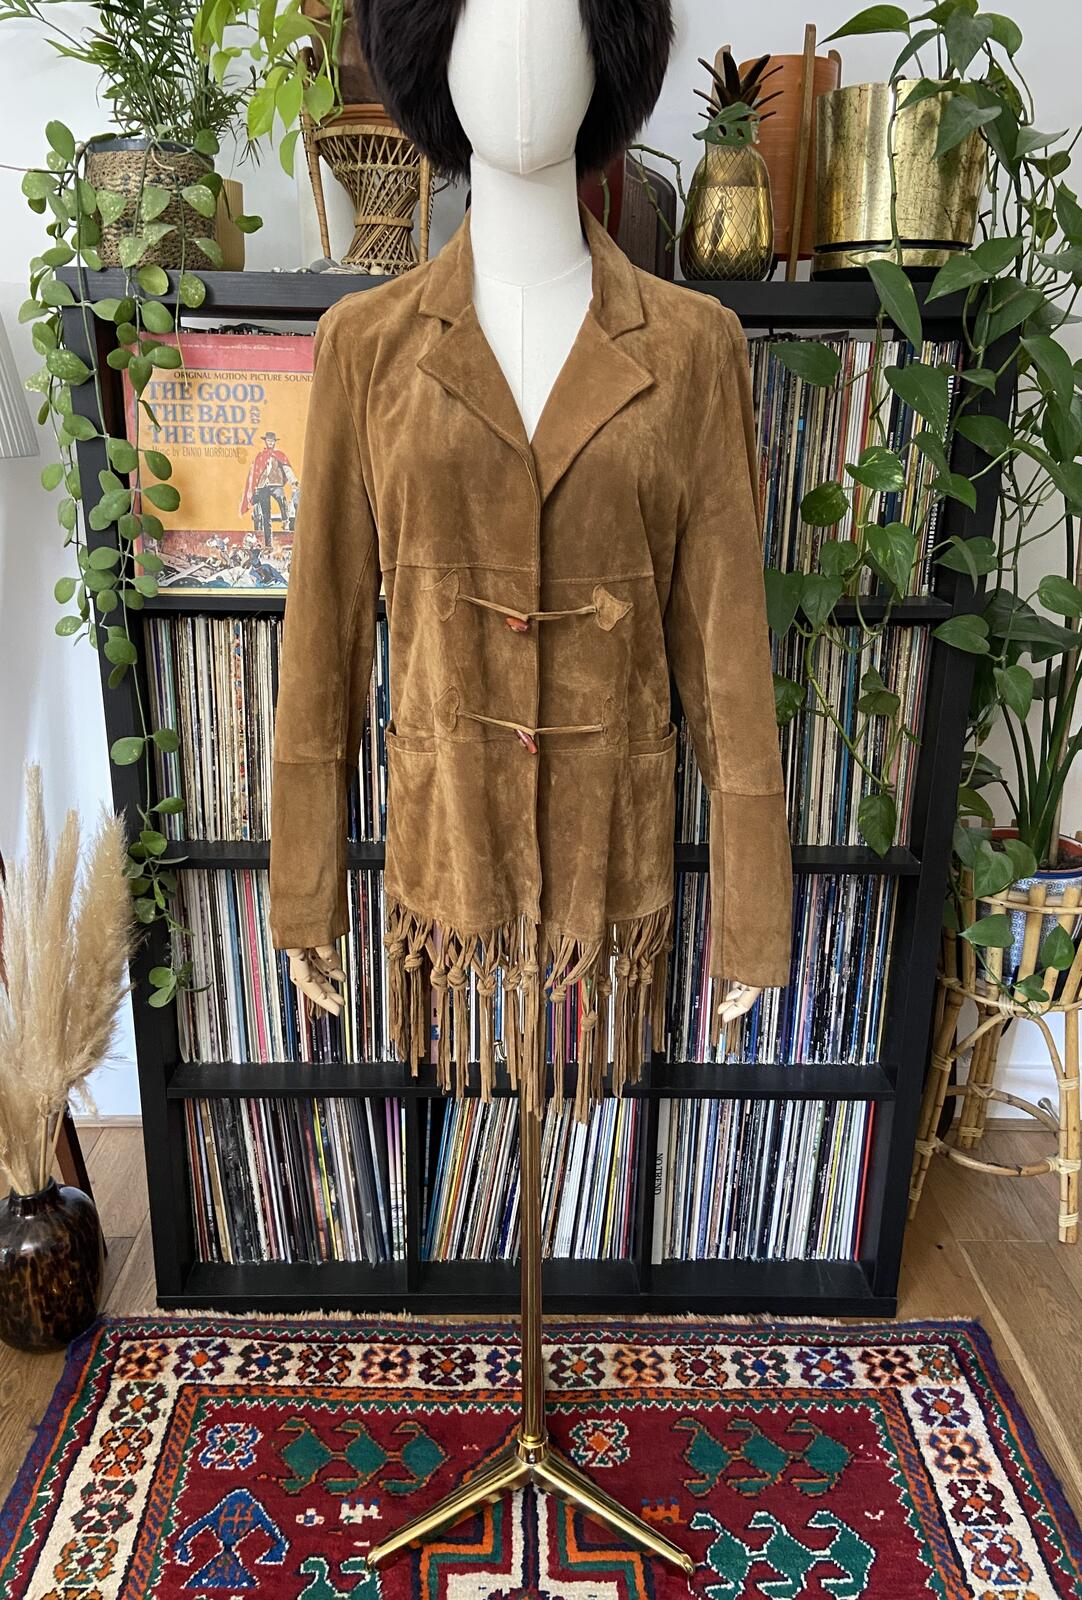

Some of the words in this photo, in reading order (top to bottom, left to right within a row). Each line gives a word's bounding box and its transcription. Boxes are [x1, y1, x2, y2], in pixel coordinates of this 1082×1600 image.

[173, 371, 211, 380] ORIGINAL
[214, 372, 248, 381] MOTION
[250, 373, 282, 382] PICTURE
[149, 381, 193, 400] THE
[149, 403, 193, 422] THE
[197, 404, 246, 424] BAD
[148, 424, 195, 444] THE
[198, 426, 257, 446] UGLY
[152, 446, 170, 456] Mic
[182, 447, 202, 457] ENNIO
